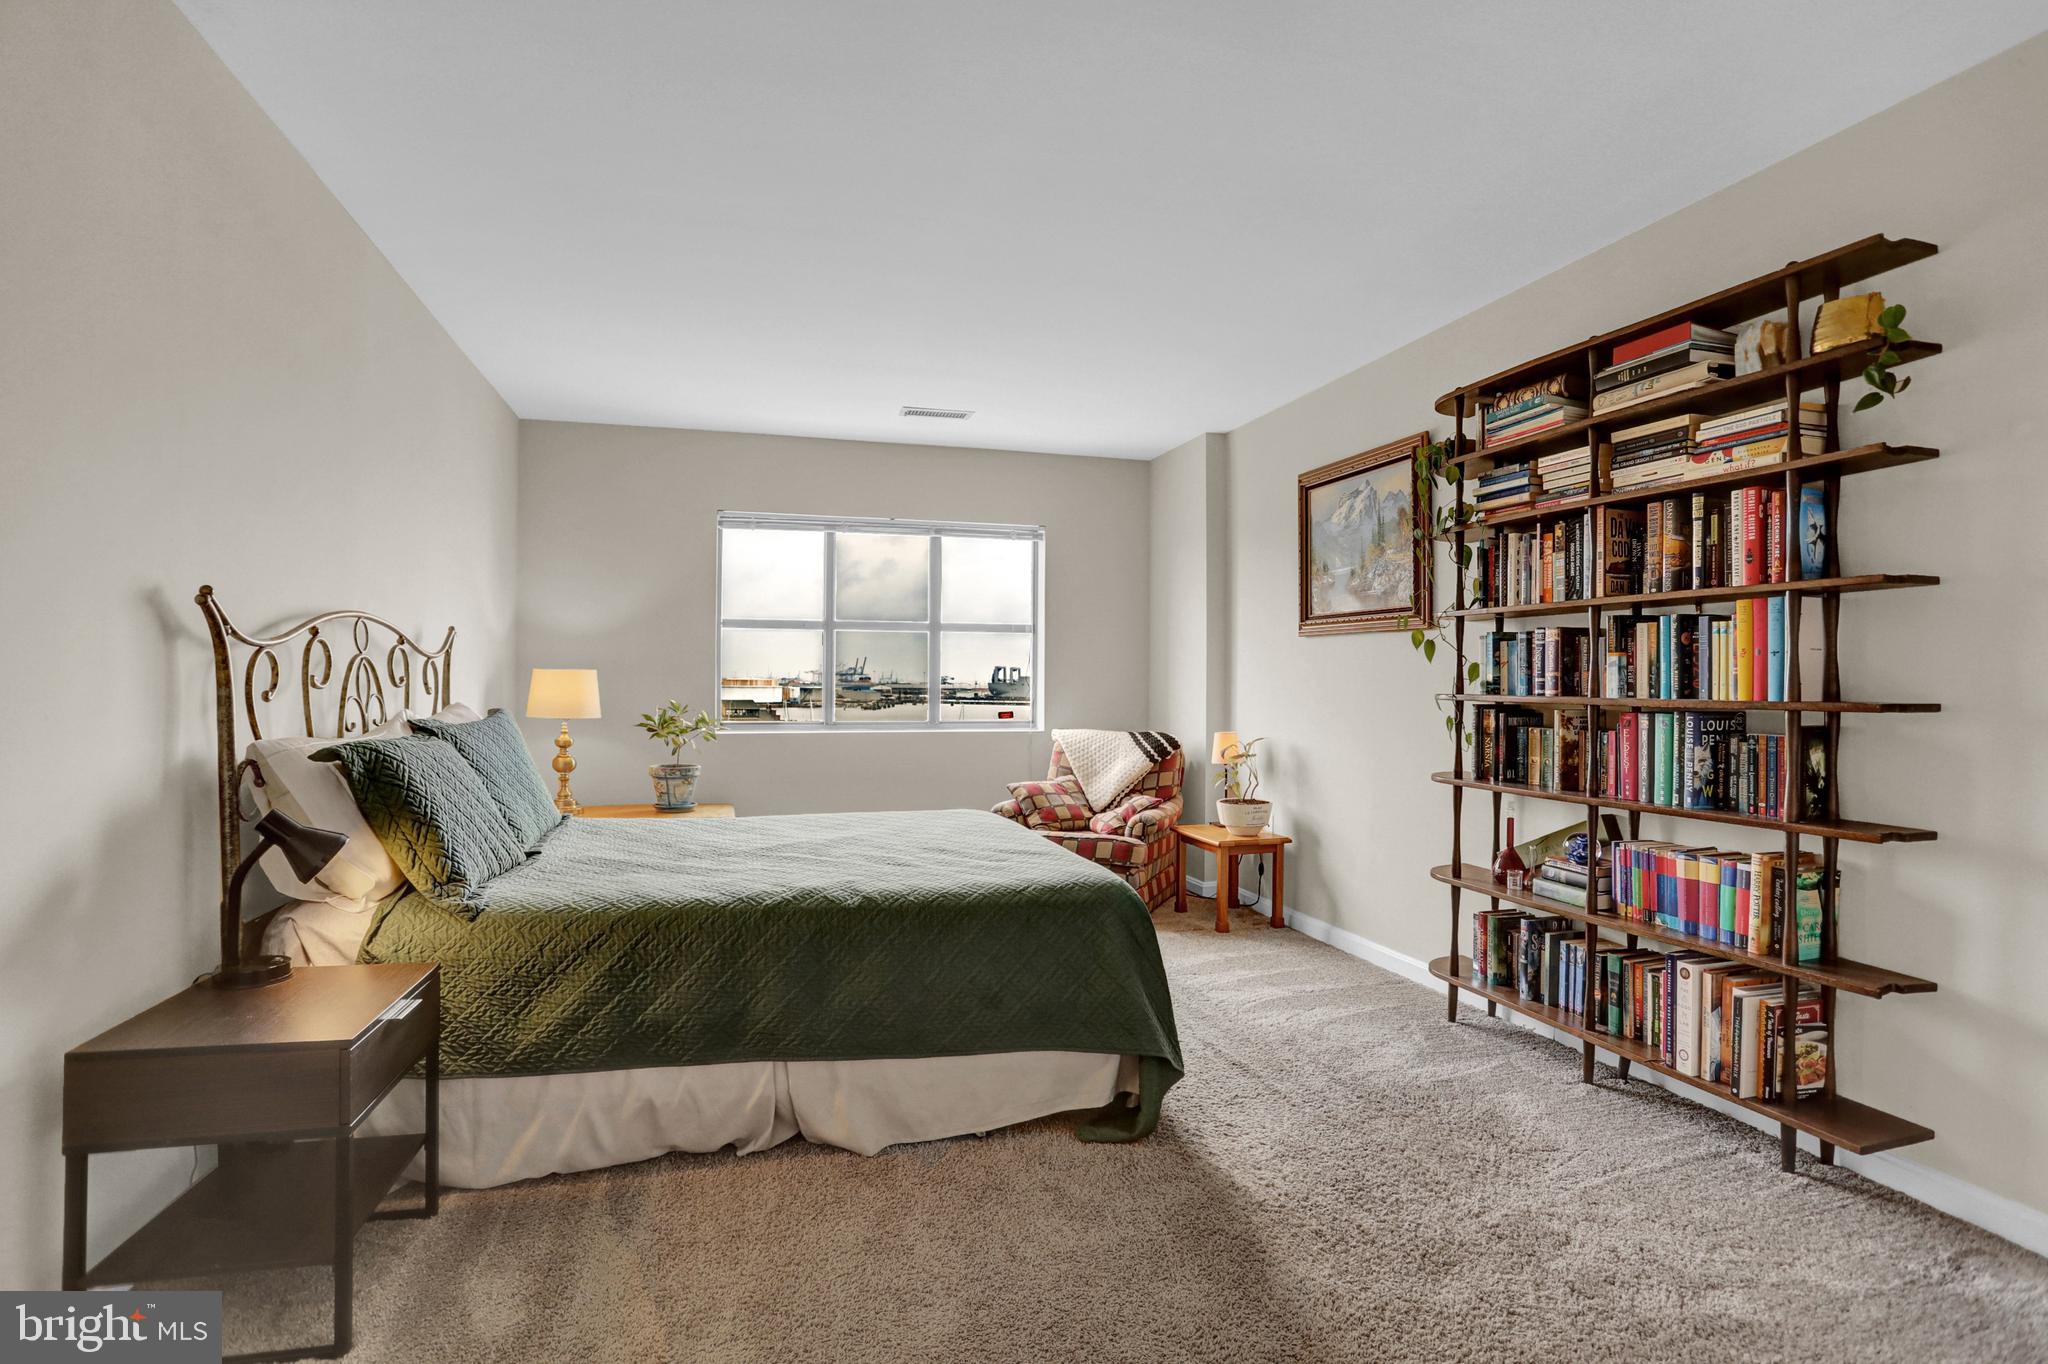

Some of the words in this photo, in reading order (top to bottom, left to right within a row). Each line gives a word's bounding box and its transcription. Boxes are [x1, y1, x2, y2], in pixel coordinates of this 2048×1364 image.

[1722, 462, 1743, 474] what
[1665, 502, 1673, 519] DAN
[1748, 489, 1756, 512] MICHAEL
[1611, 517, 1624, 538] DA
[1665, 520, 1673, 545] BROWN
[1543, 540, 1552, 563] SAS
[1664, 557, 1672, 592] INFERNO
[1753, 870, 1762, 894] HARRY
[1753, 894, 1761, 920] POTTER
